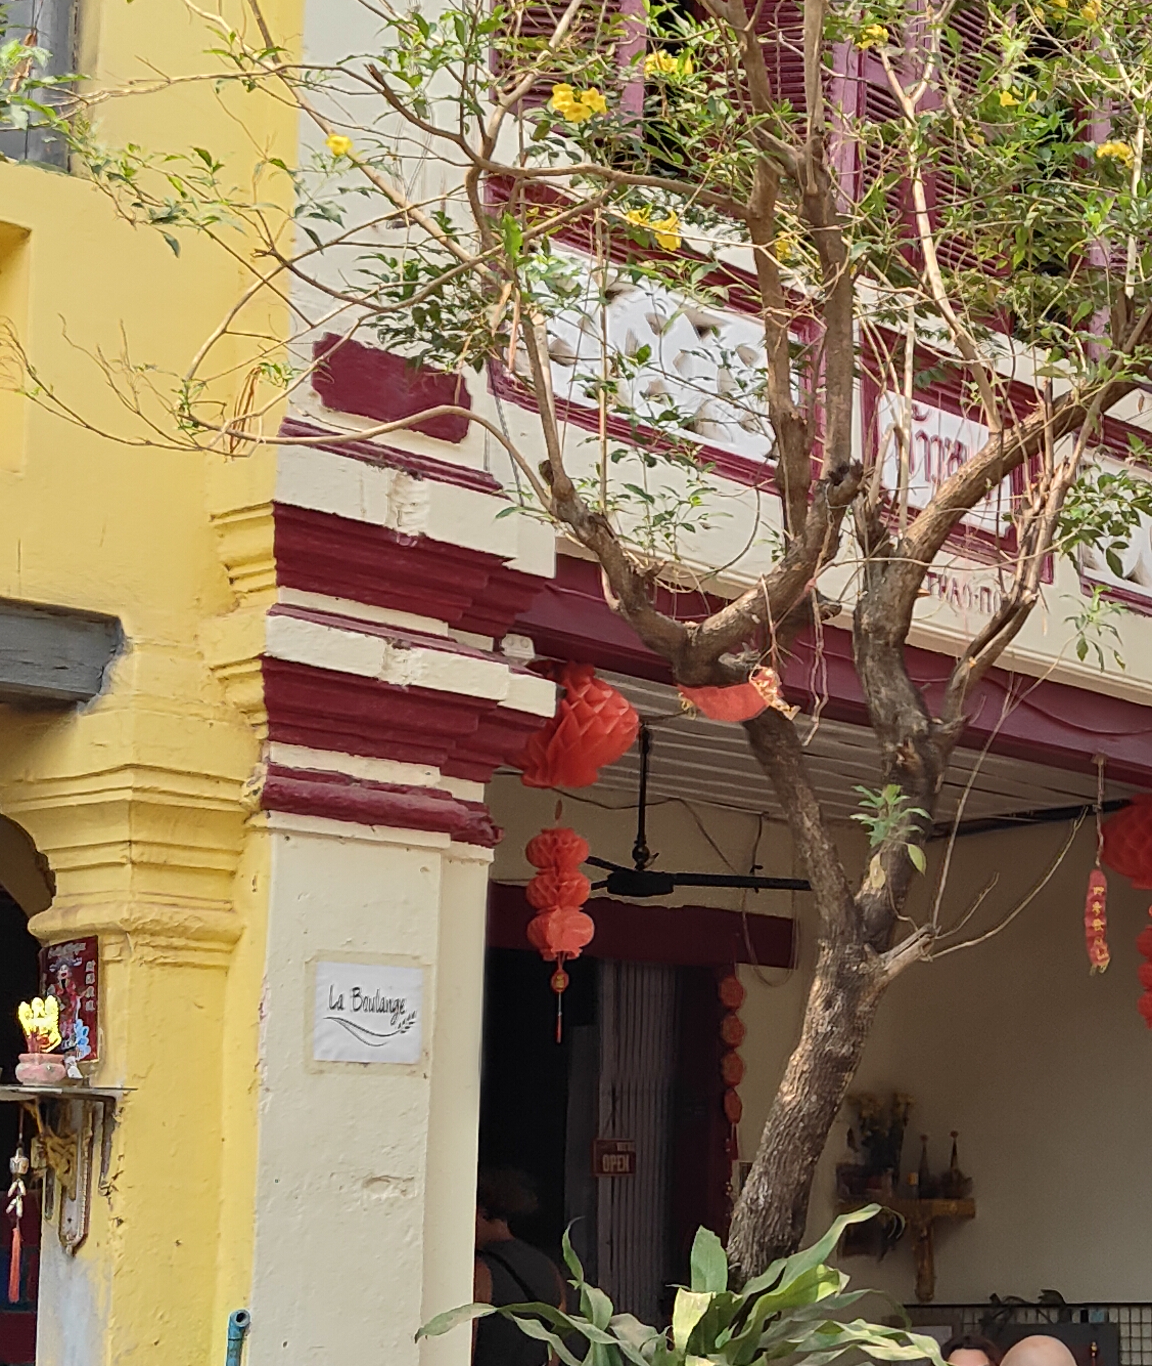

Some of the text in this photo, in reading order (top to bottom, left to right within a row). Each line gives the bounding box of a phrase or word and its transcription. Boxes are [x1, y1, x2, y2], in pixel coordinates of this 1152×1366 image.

[328, 984, 407, 1027] La Boulange
[602, 1154, 630, 1172] OPEN
